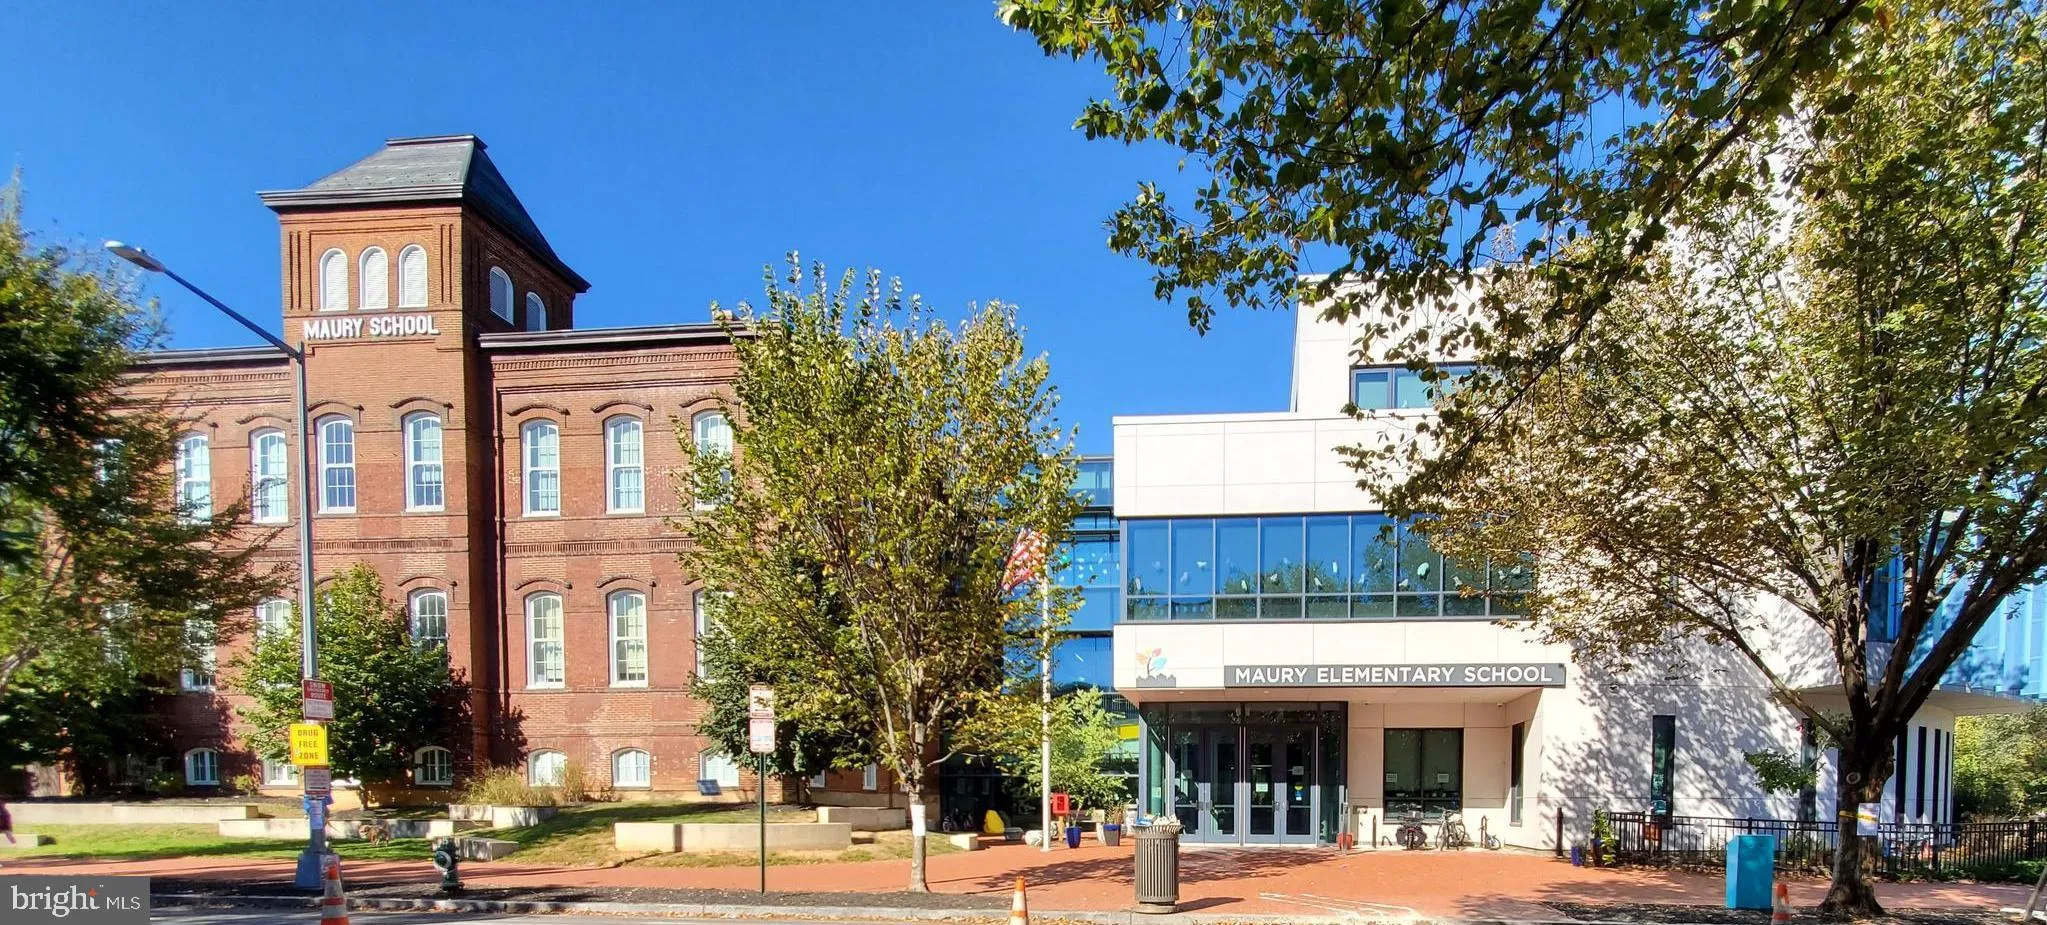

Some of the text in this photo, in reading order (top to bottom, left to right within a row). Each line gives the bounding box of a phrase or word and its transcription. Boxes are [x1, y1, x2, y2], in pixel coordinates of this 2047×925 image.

[303, 315, 440, 340] MAURY SCHOOL
[1235, 666, 1552, 683] MAURY ELEMENTARY SCHOOL
[298, 740, 318, 748] FREE
